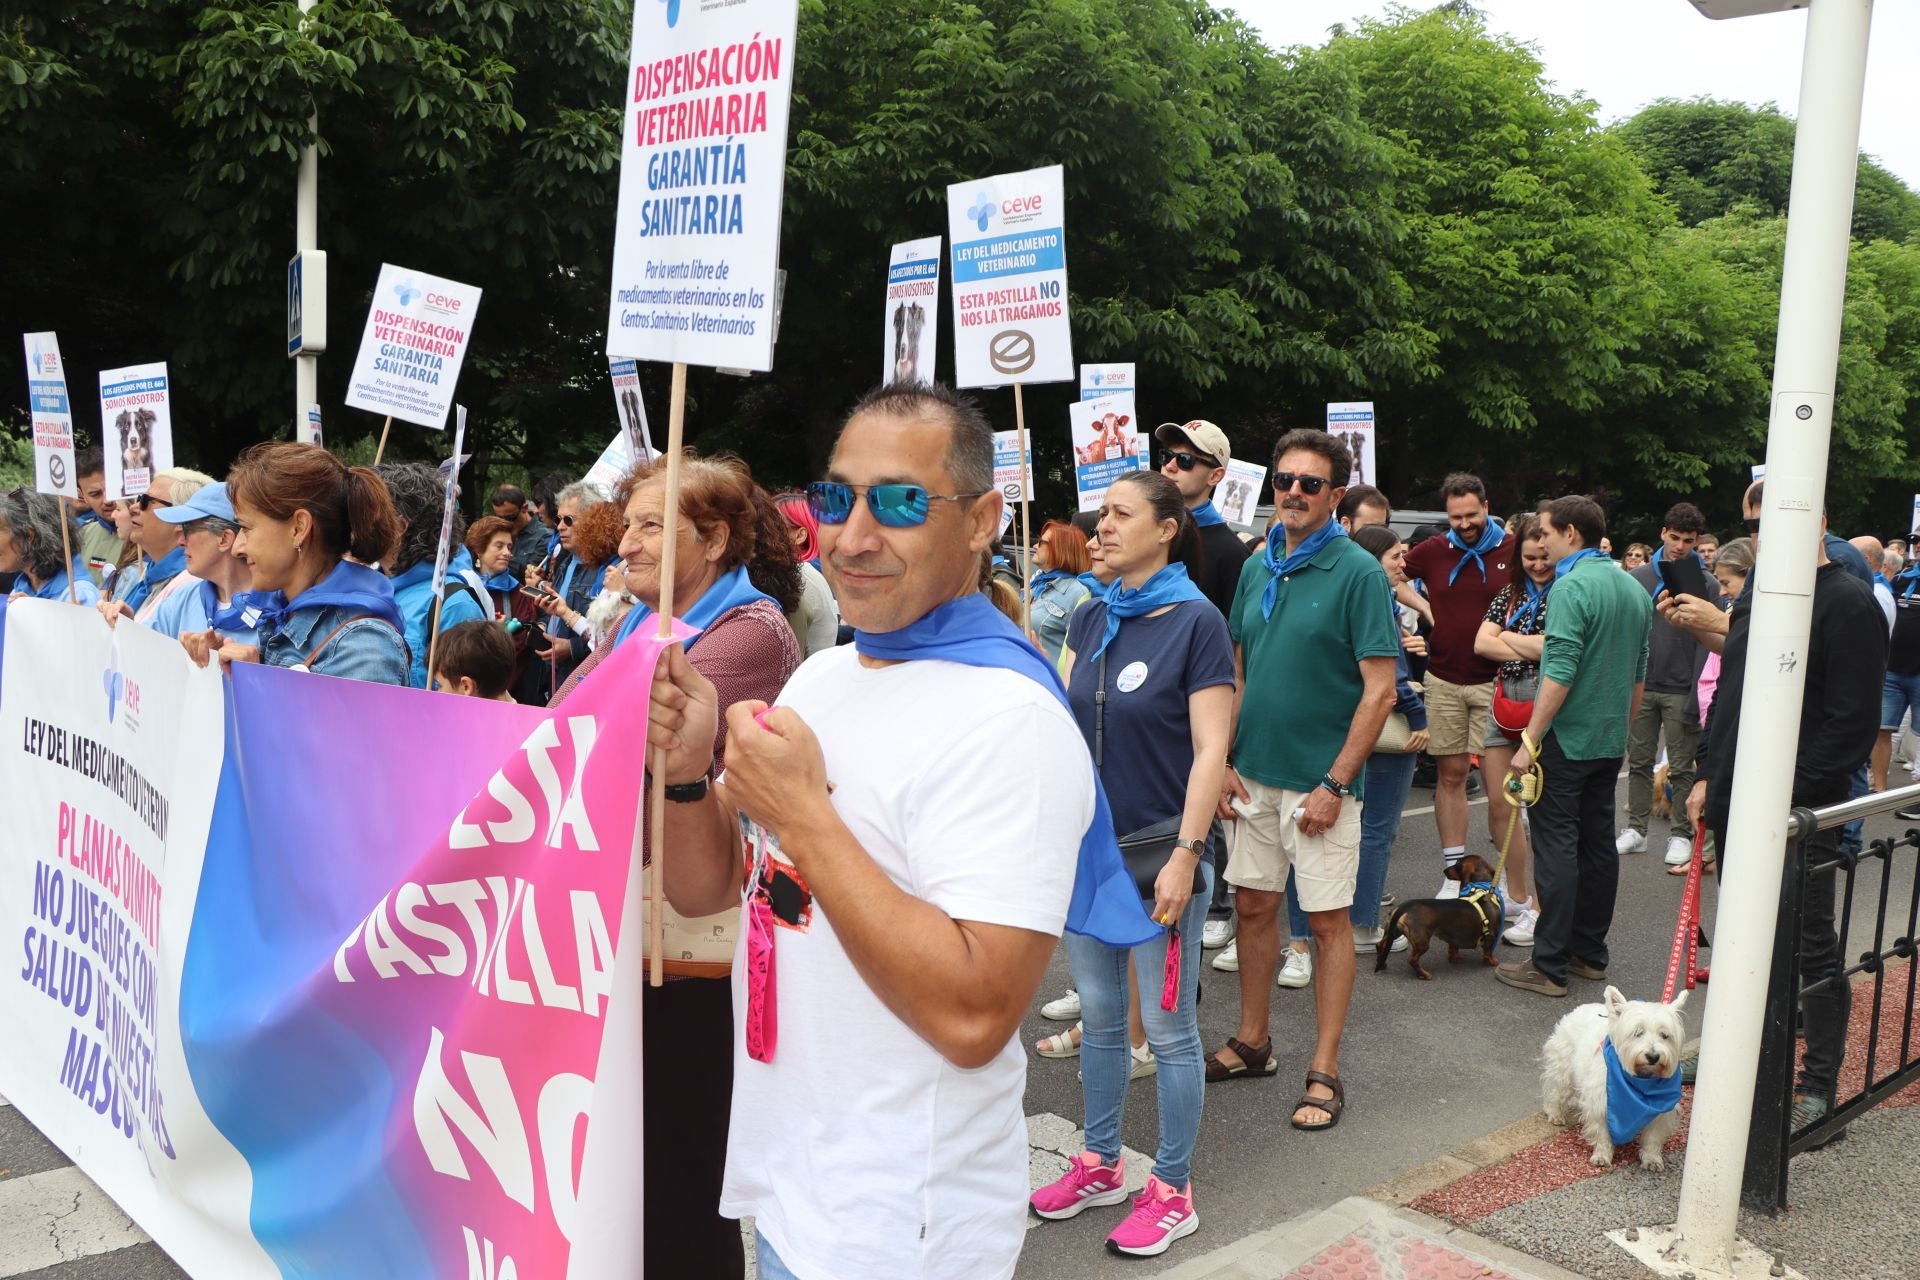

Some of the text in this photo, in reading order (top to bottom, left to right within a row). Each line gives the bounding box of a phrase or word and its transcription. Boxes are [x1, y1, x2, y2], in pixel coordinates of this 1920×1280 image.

[634, 32, 782, 103] DISPENSACIÓN
[637, 91, 766, 147] VETERINARIA
[648, 136, 746, 190] GARANTÍA
[640, 194, 743, 237] SANITARIA
[1002, 195, 1042, 214] ceve
[958, 234, 1057, 262] LEY DEL MEDICAMENTO
[645, 260, 729, 280] Por la venta libre de
[914, 264, 922, 275] POR
[923, 264, 927, 274] EL
[978, 254, 1036, 273] VETERINARIO
[426, 292, 461, 310] ceve
[618, 285, 764, 309] medicamentos veterinarios en los
[889, 281, 934, 299] SOMOS NOSOTROS
[960, 280, 1060, 310] ESTA PASTILLA NO
[374, 310, 464, 344] DISPENSACIÓN
[621, 309, 756, 336] Centros Sanitarios Veterinarios
[961, 302, 1062, 327] NOS LA TRAGAMOS
[374, 326, 455, 358] VETERINARIA
[380, 344, 443, 370] GARANTÍA
[373, 358, 439, 385] SANITARIA
[105, 392, 165, 410] SOMOS NOSOTROS
[356, 383, 394, 397] medicamentos
[396, 393, 428, 406] veterinarios
[392, 383, 407, 392] venta
[408, 387, 421, 395] libre
[357, 391, 439, 417] Centros Sanitarios Veterinarios
[126, 678, 139, 715] ceve
[24, 716, 46, 757] LEY
[47, 724, 69, 768] DEL
[449, 714, 600, 851] ESTA
[58, 801, 121, 898] PLANAS
[34, 860, 157, 1036] NO JUEGUES CON
[334, 876, 616, 1018] PASTILLA
[22, 926, 93, 1017] SALUD
[96, 969, 110, 1044] DE
[413, 1026, 595, 1244] NO
